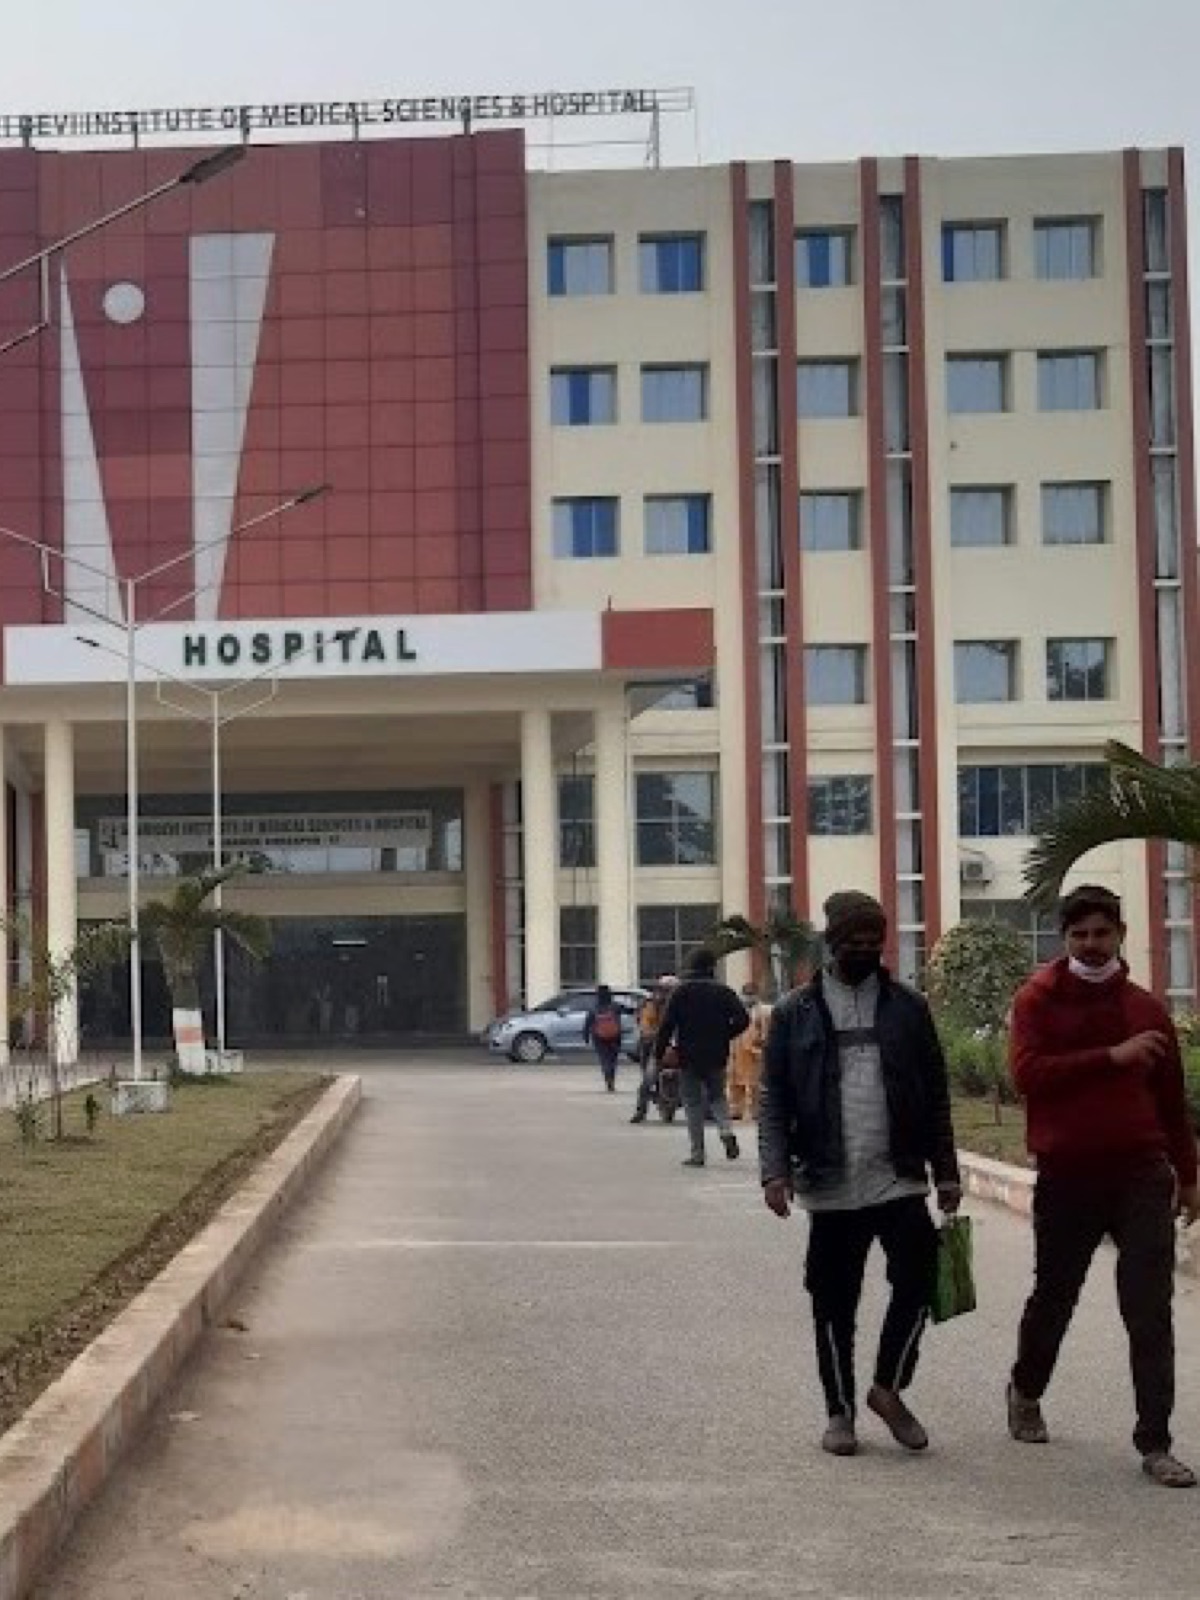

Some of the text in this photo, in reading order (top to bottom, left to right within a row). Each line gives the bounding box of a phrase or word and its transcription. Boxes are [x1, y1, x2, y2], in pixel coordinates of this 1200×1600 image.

[78, 108, 213, 135] INSTITUTE
[261, 101, 379, 128] MEDICAL
[383, 94, 502, 122] SCIENCES
[534, 88, 656, 116] HOSPITAL
[184, 629, 417, 666] HOSPITAL
